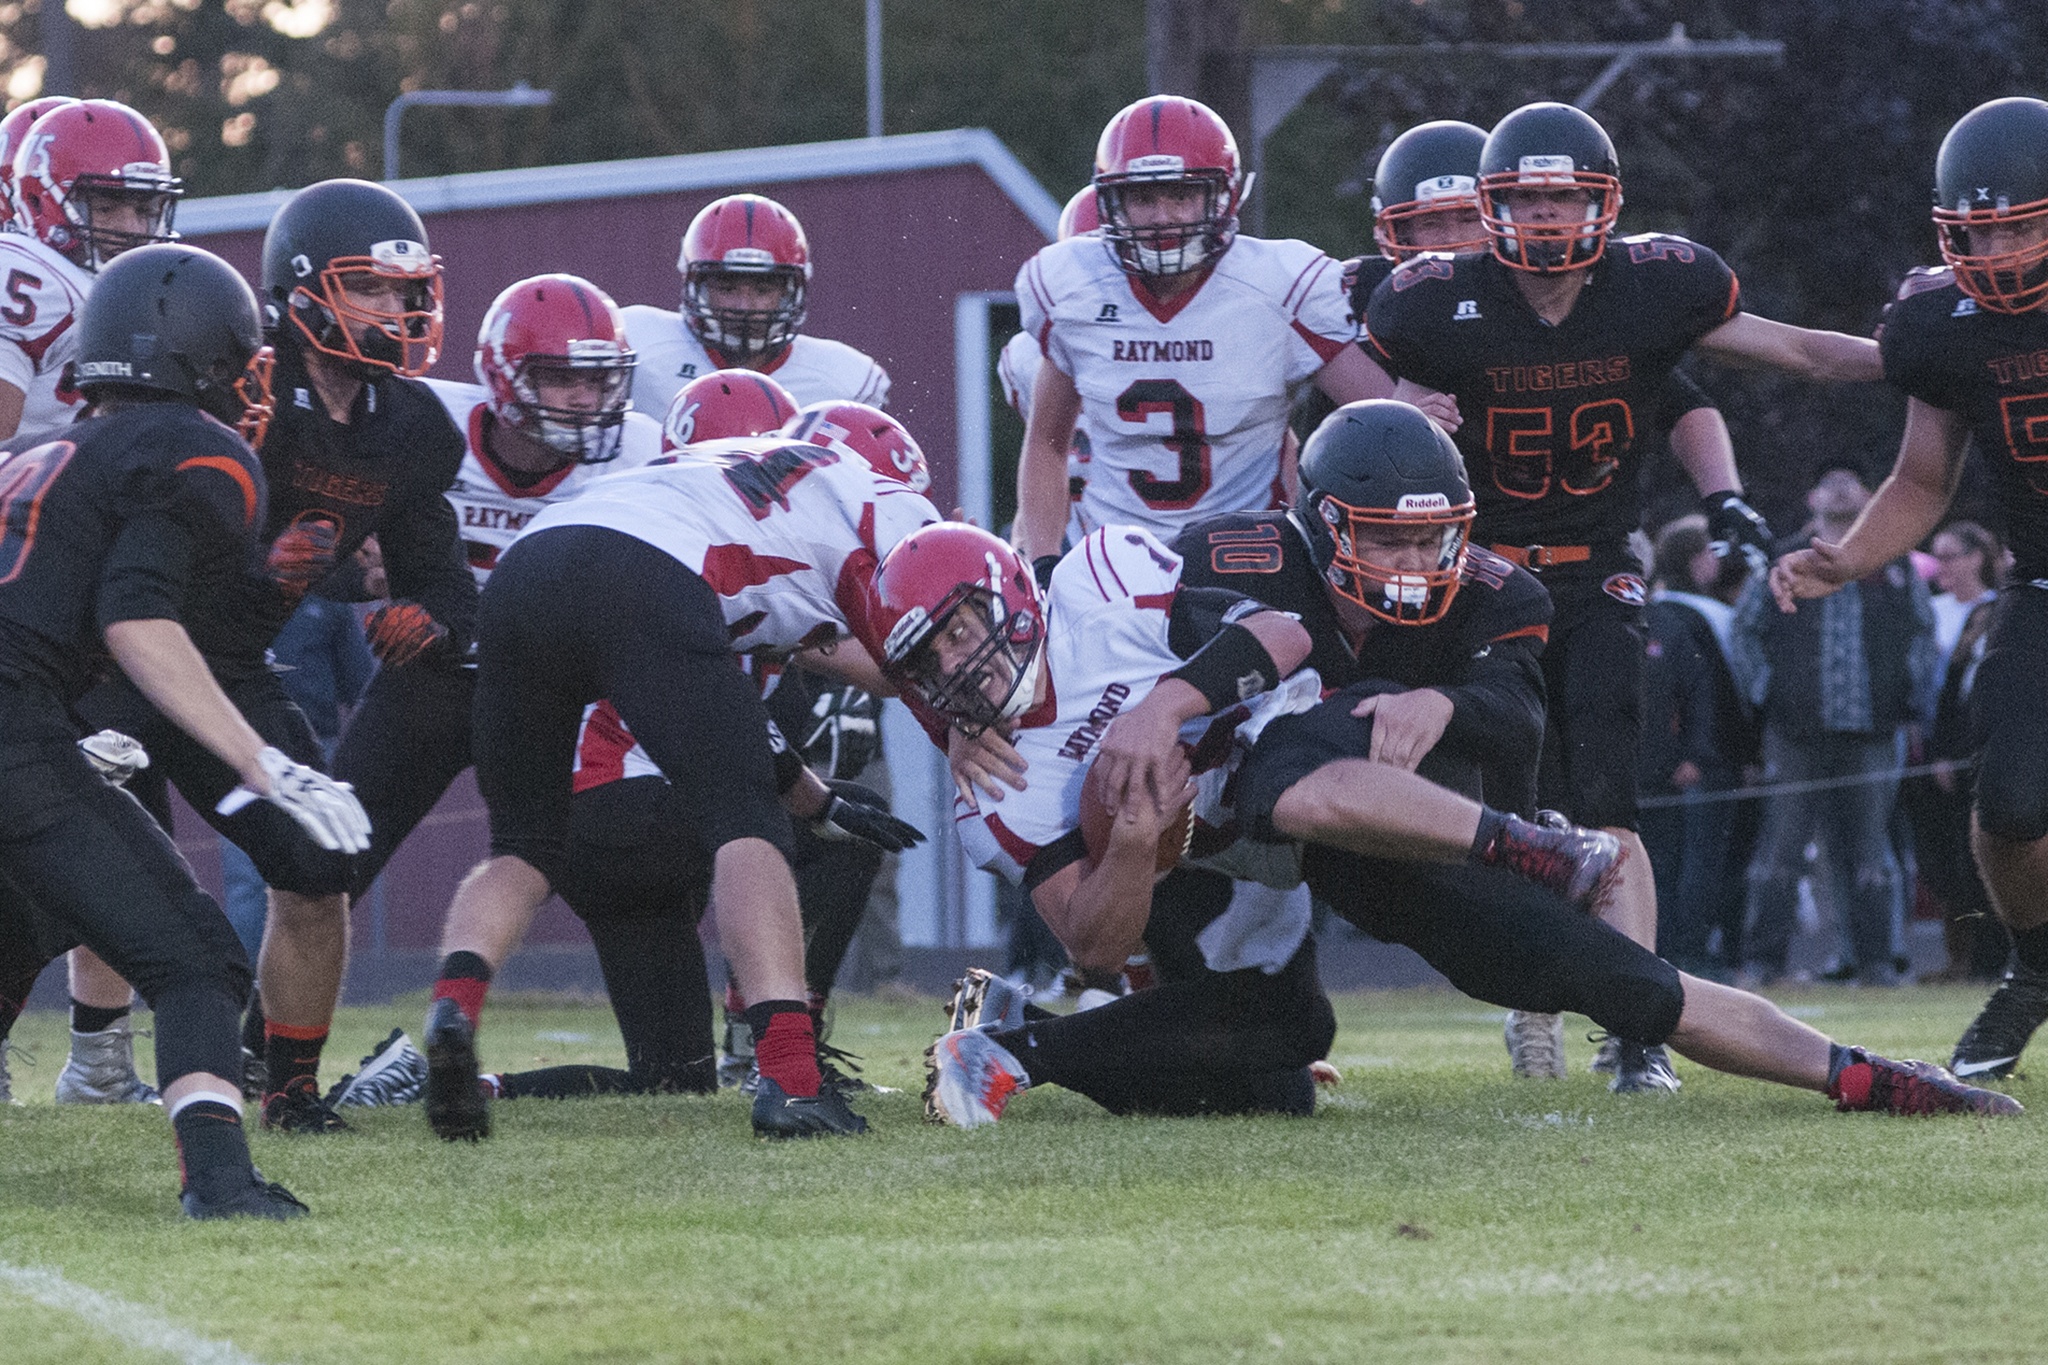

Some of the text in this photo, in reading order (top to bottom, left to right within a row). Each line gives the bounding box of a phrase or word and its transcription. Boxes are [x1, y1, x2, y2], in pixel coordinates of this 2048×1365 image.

[1113, 339, 1213, 362] RAYMOND
[1485, 356, 1630, 392] TIGERS
[1116, 379, 1212, 510] 3
[1486, 398, 1635, 499] 53
[1405, 498, 1445, 508] Riddell
[1209, 523, 1283, 574] 10
